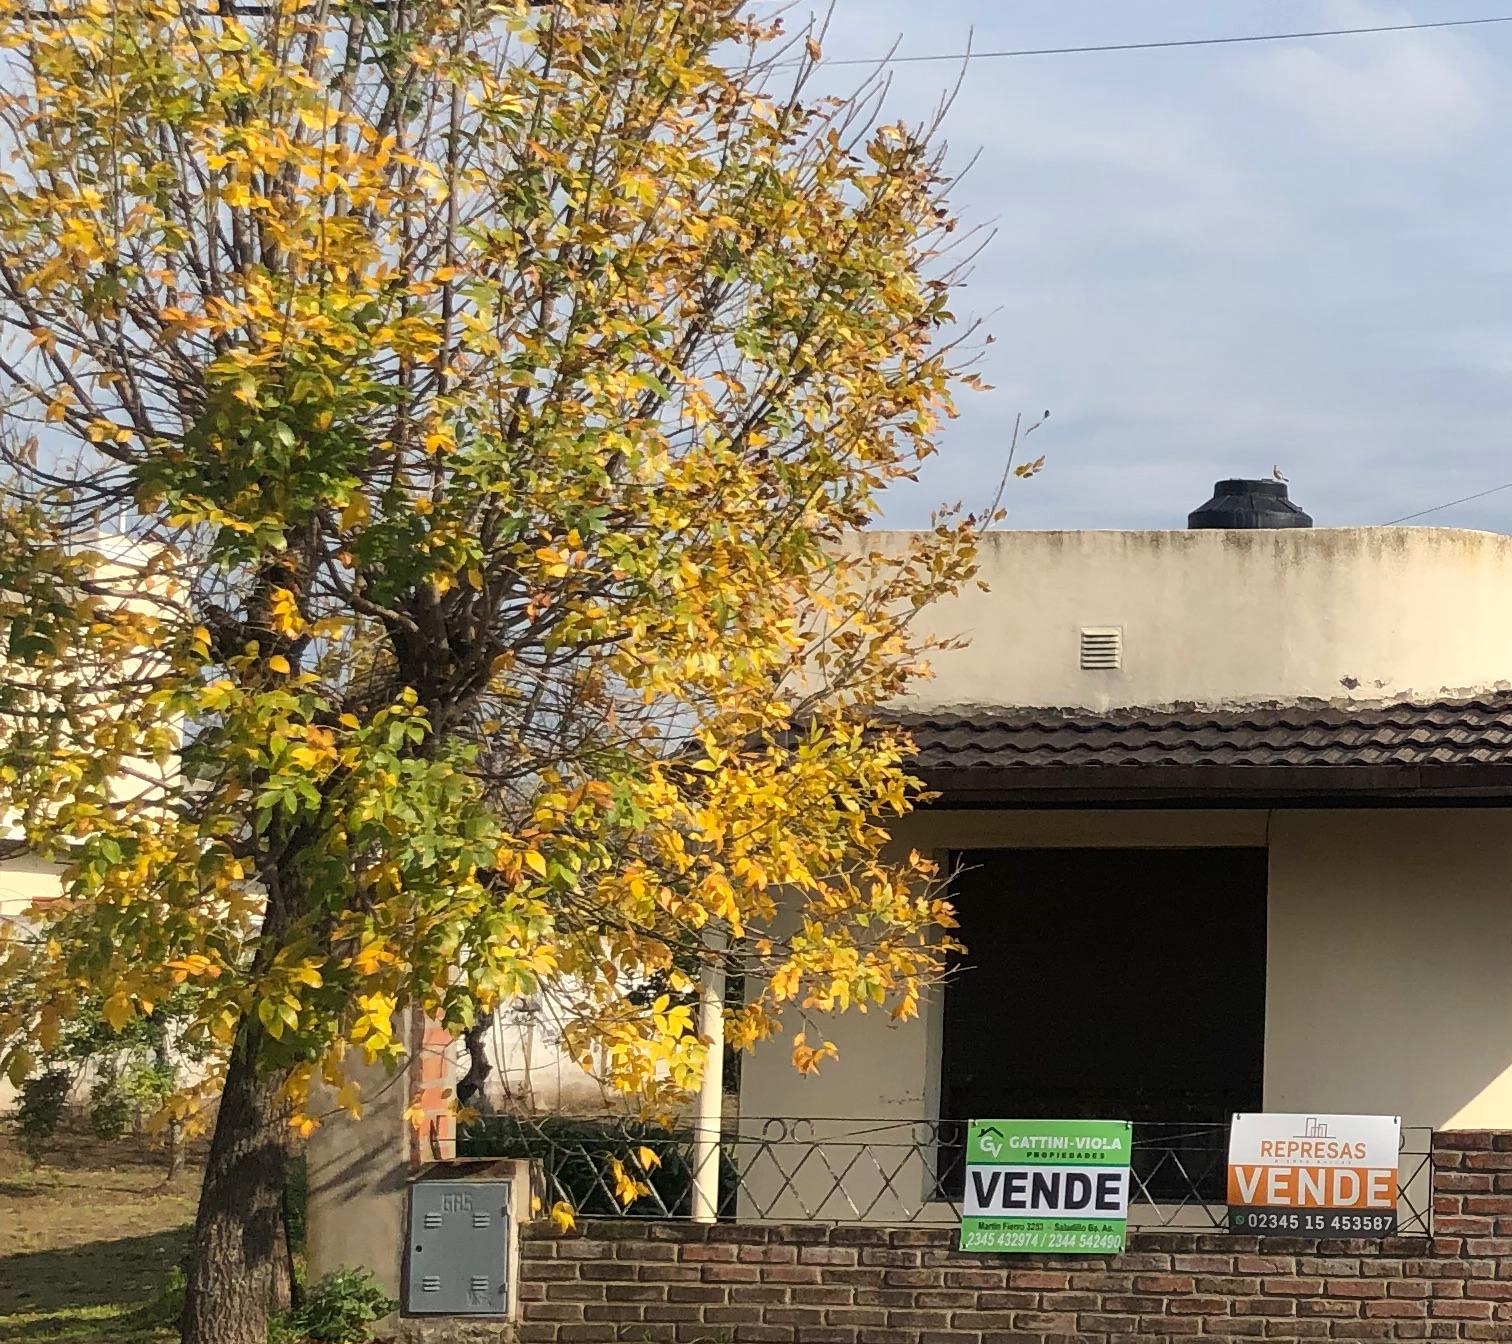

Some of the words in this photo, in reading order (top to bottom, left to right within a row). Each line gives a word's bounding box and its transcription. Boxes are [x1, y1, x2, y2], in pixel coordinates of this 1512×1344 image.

[1009, 1136, 1122, 1150] GATTINI-VIOLA
[1260, 1140, 1367, 1160] REPRESAS
[1026, 1151, 1105, 1159] PROPIEDADES
[971, 1171, 1122, 1210] VENDE
[1235, 1166, 1393, 1207] VENDE
[441, 1193, 472, 1213] GAS
[1248, 1214, 1299, 1229] 02345
[1305, 1215, 1325, 1230] 15
[1331, 1216, 1393, 1231] 453587
[968, 1232, 995, 1246] 2345
[998, 1232, 1039, 1247] 432974
[1048, 1233, 1076, 1248] 2344
[1079, 1234, 1121, 1248] 542490
